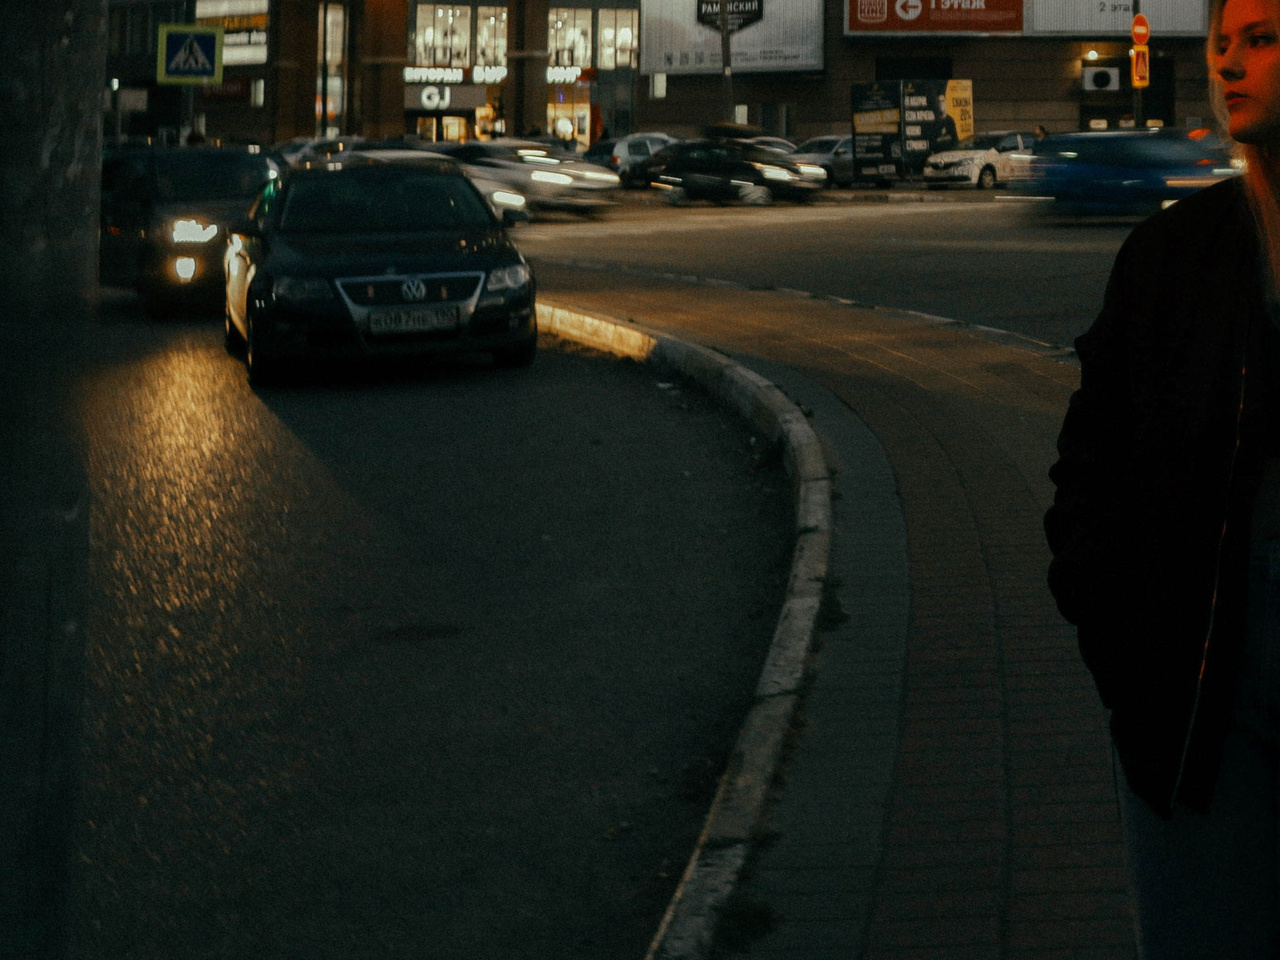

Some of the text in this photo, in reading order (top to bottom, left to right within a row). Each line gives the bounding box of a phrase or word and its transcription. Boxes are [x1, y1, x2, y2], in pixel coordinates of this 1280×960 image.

[702, 0, 759, 15] РАМНСКИЙ
[1099, 1, 1135, 12] 2 эта
[421, 86, 450, 110] GJ
